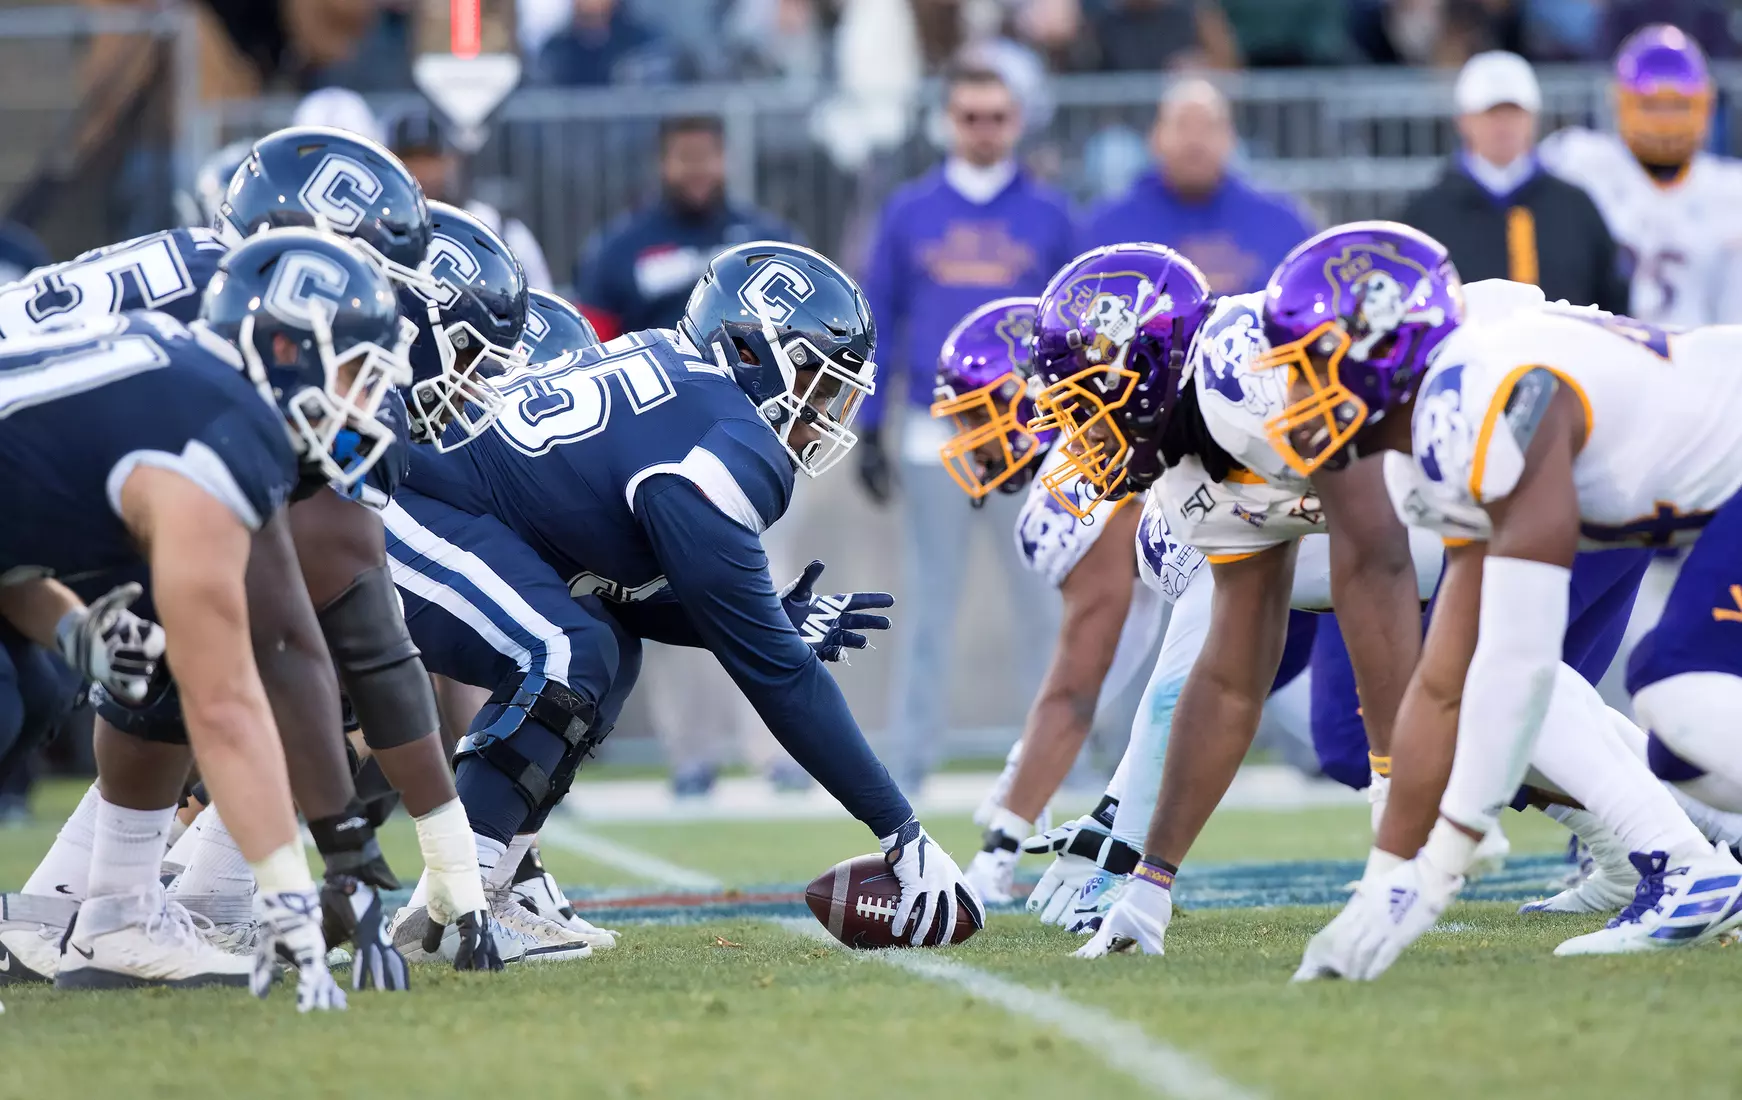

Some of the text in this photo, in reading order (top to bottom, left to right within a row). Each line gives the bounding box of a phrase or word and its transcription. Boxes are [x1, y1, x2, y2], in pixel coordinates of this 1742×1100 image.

[299, 153, 384, 233] C
[264, 249, 350, 330] C
[407, 232, 482, 310] C
[737, 258, 816, 327] C
[1069, 284, 1093, 317] ECU
